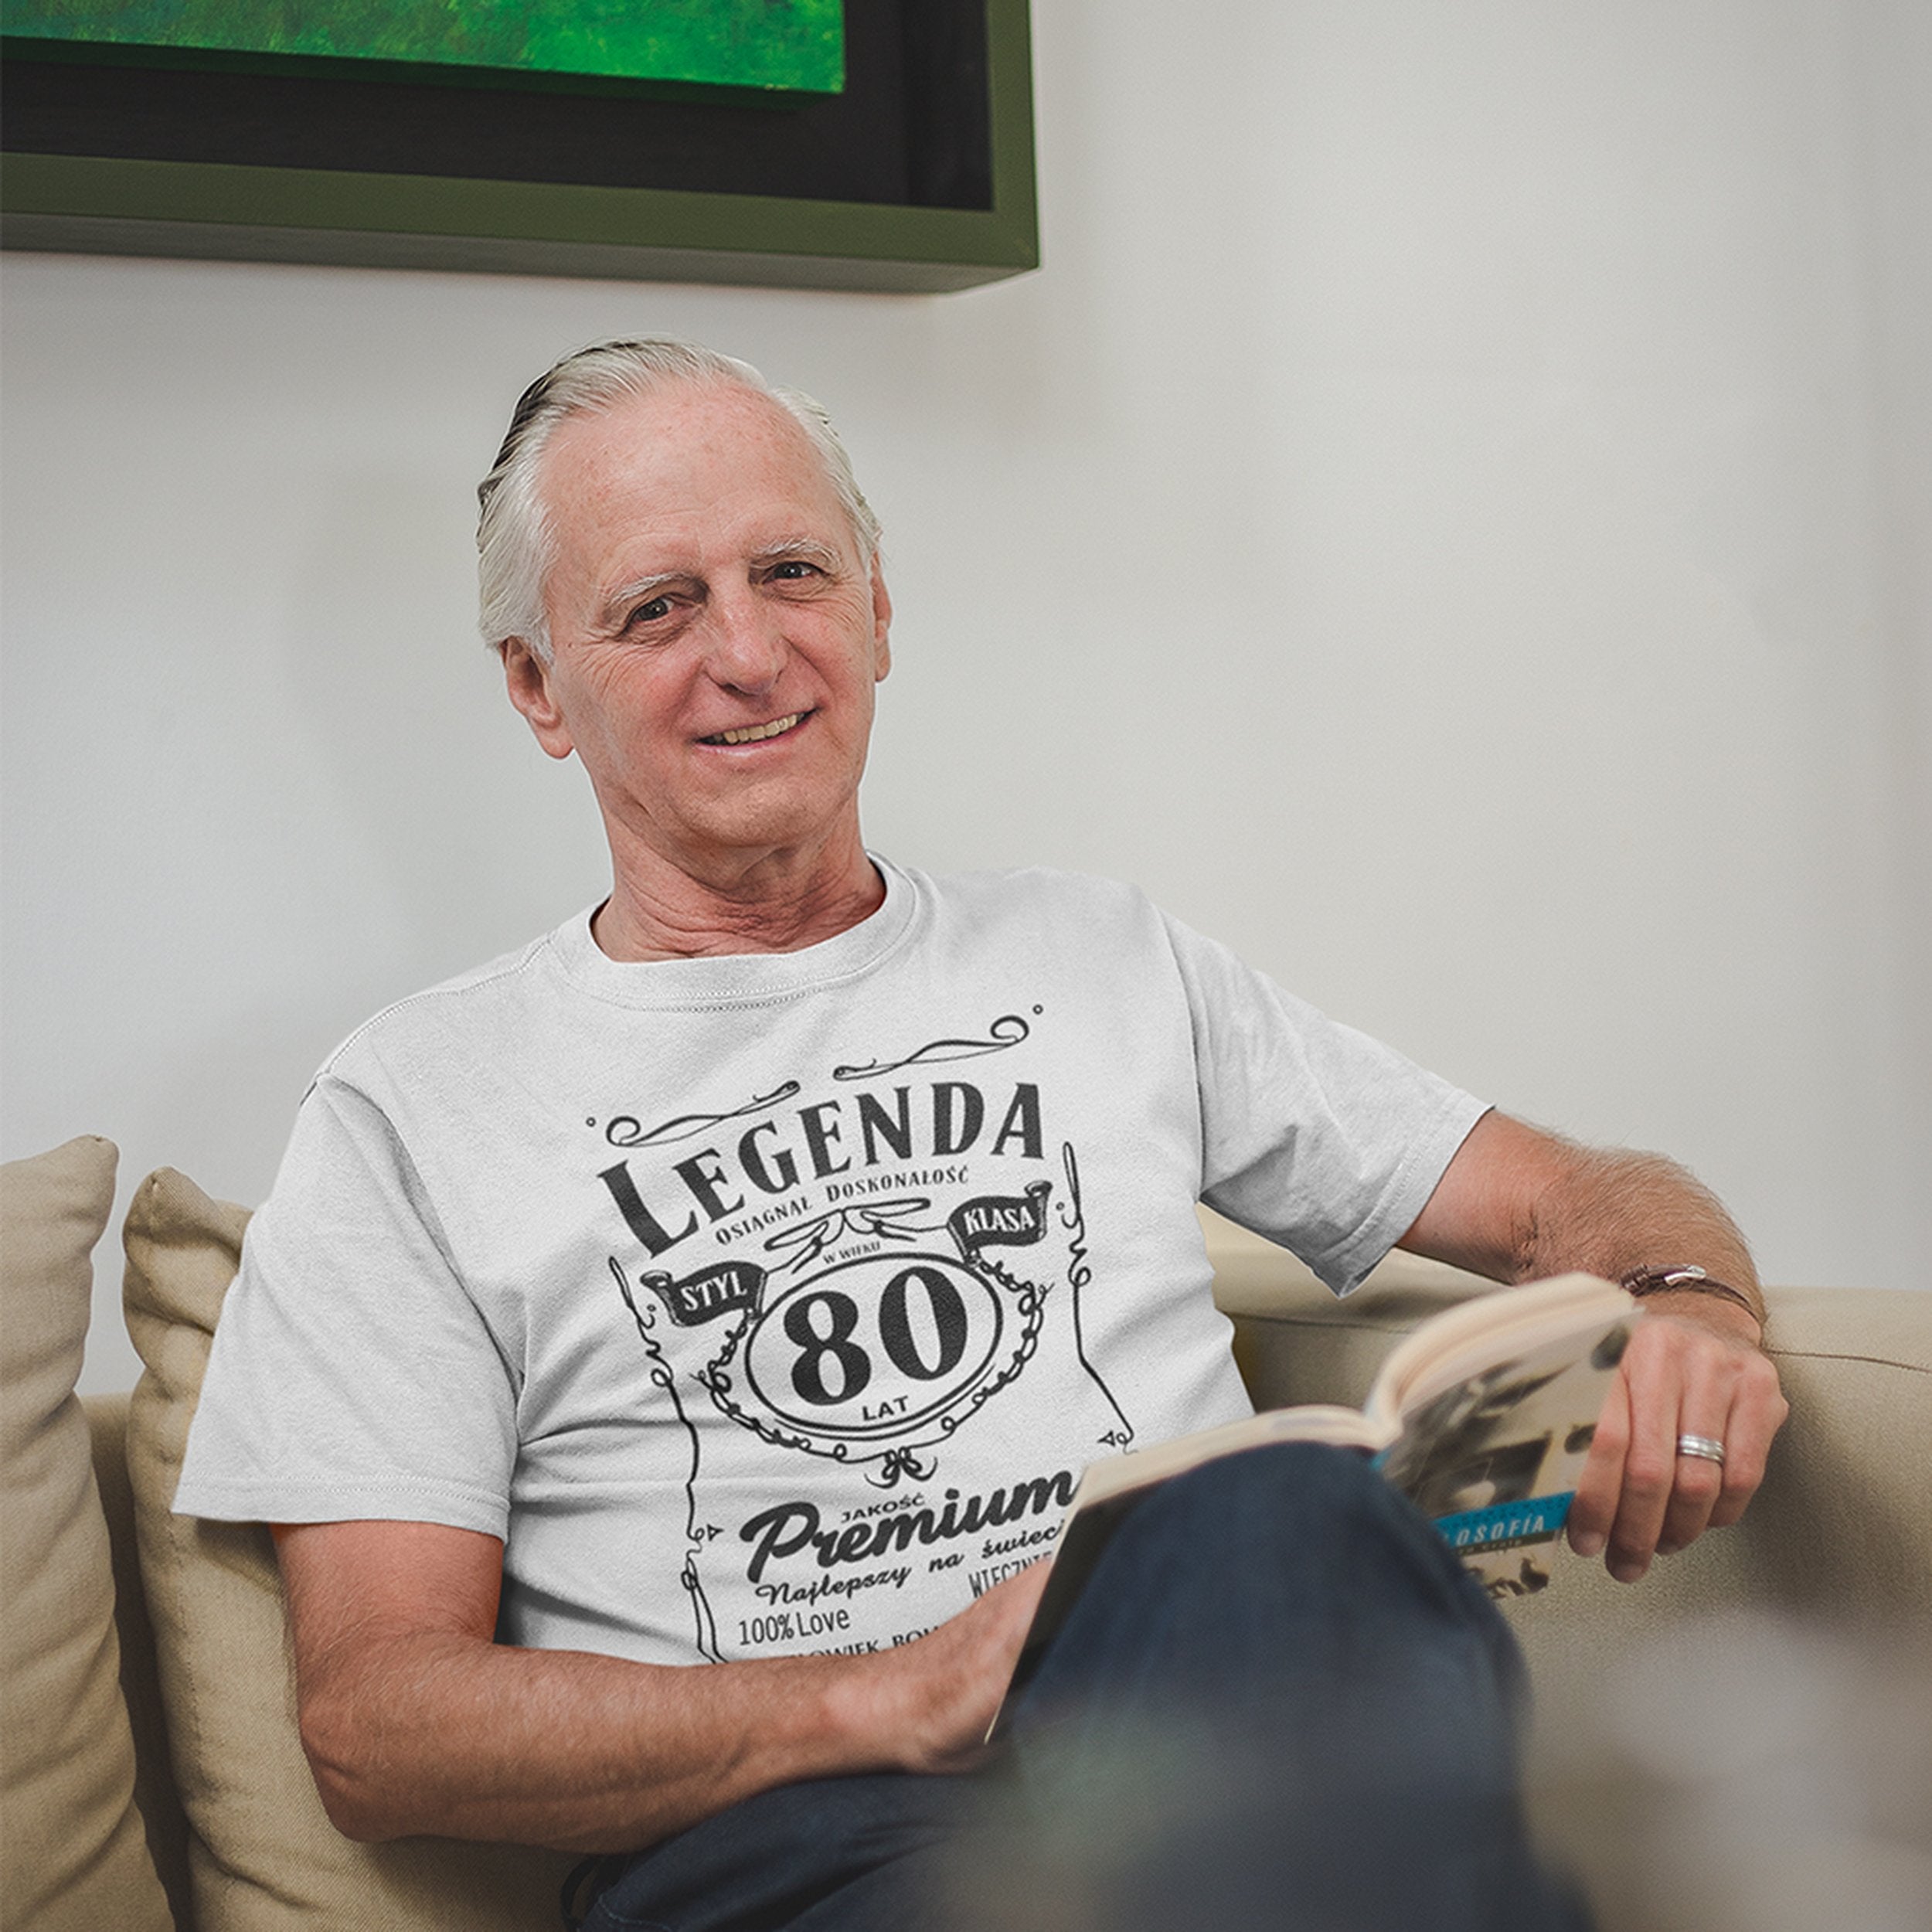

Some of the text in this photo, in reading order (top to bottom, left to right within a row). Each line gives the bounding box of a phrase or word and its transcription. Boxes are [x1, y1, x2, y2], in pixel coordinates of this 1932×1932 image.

[597, 1082, 1044, 1258] LEGENDA
[964, 1206, 1036, 1236] KLASA
[680, 1271, 748, 1311] STYL
[782, 1266, 968, 1406] 80
[862, 1396, 910, 1422] LAT
[739, 1469, 1083, 1583] Premium
[841, 1492, 926, 1524] JAKOŚĆ
[755, 1566, 913, 1606] Najlepszy
[928, 1553, 965, 1573] na
